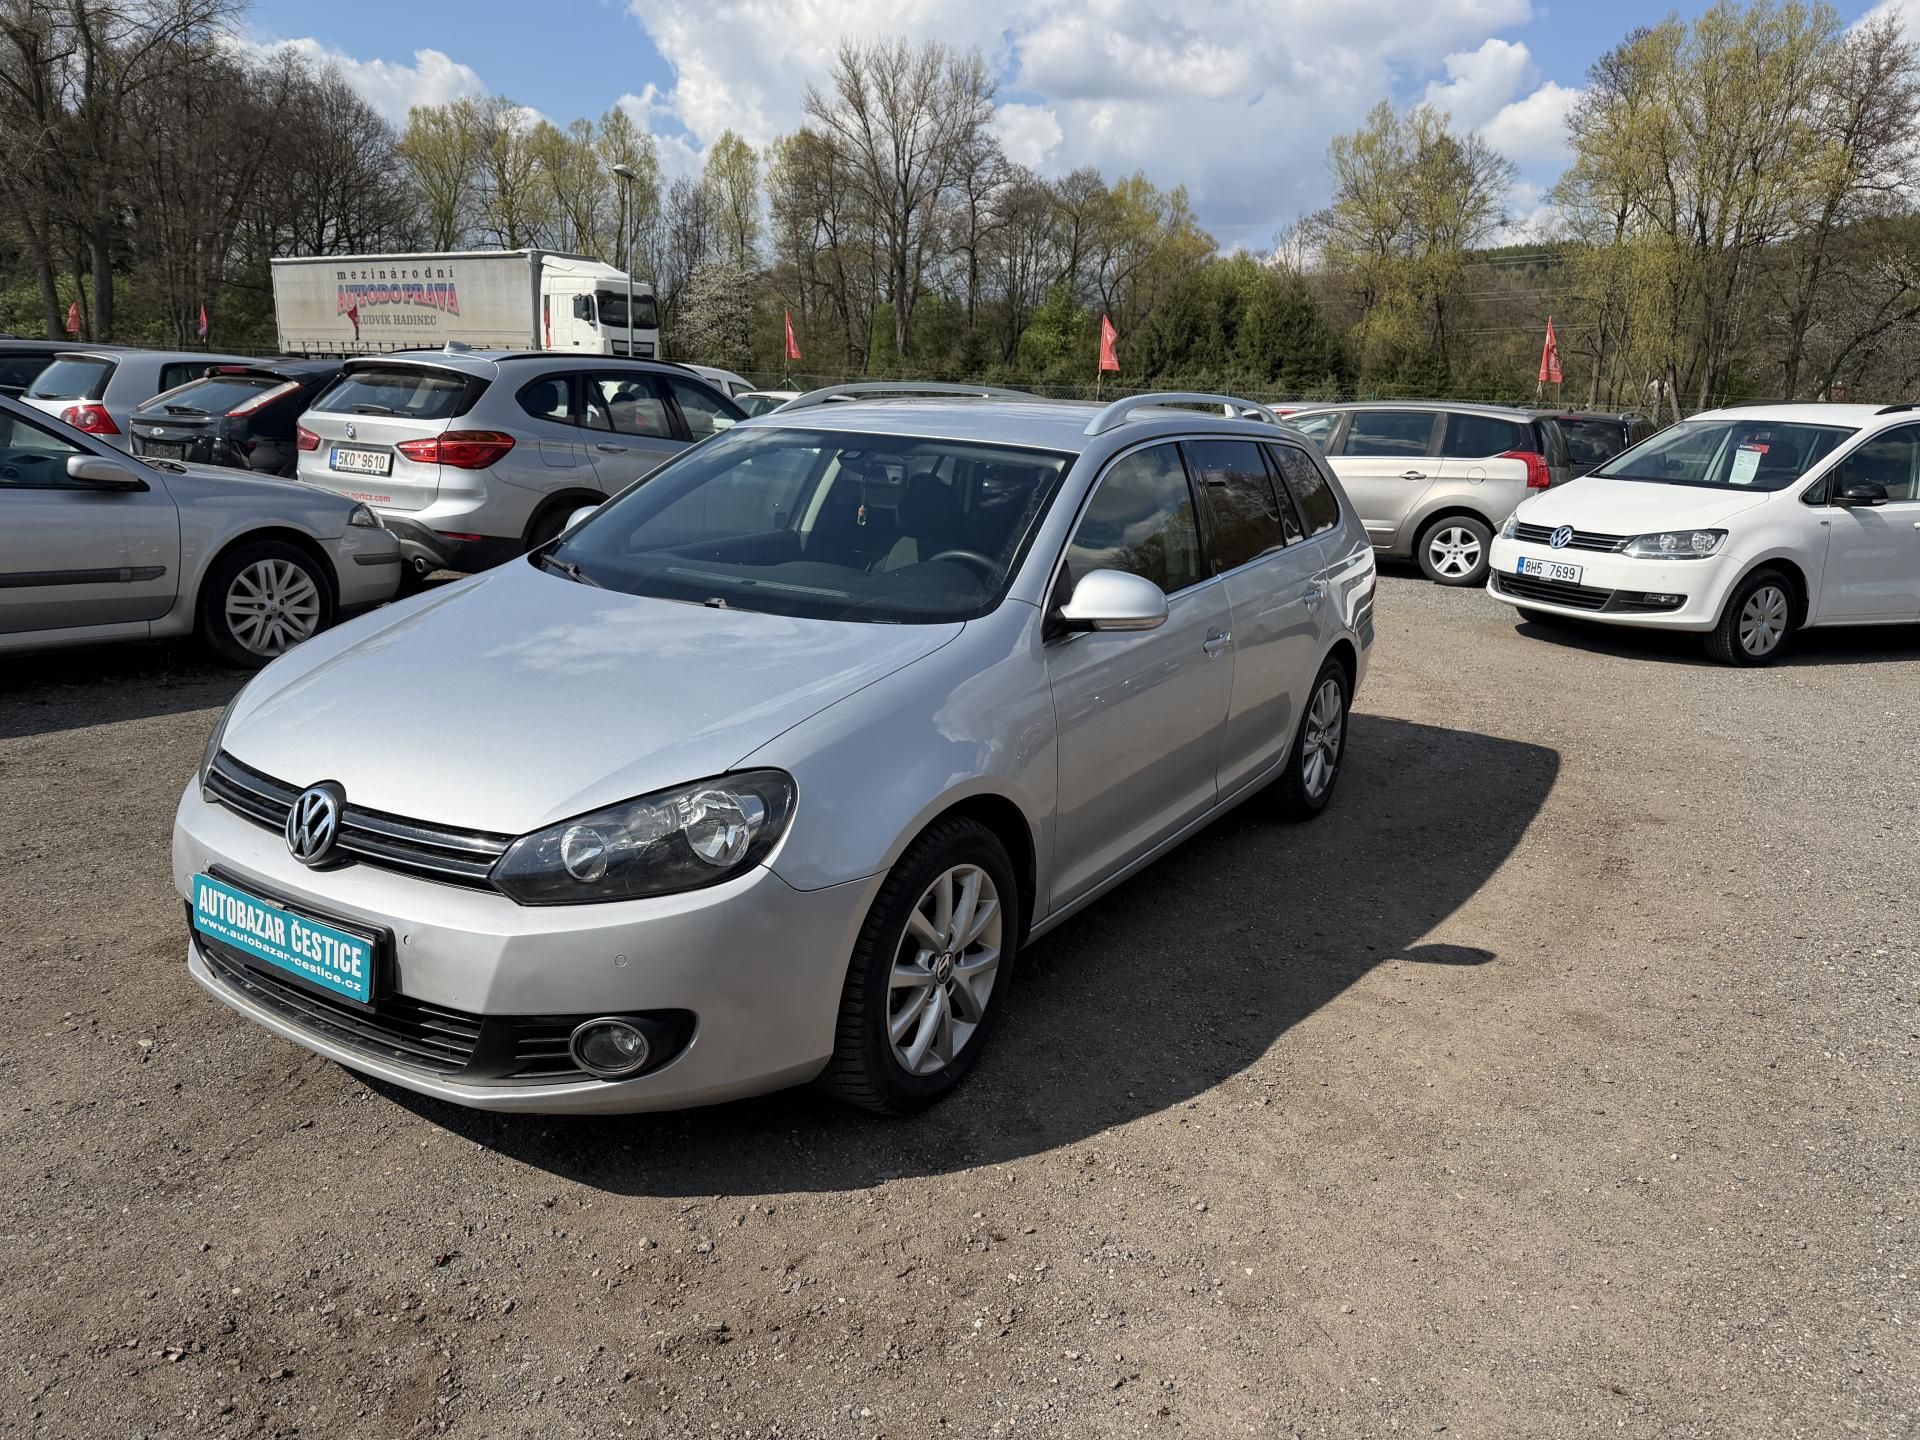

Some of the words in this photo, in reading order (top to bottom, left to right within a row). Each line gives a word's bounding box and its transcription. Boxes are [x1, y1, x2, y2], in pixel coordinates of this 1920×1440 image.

[337, 266, 454, 280] mezinárodní
[336, 283, 460, 317] AUTODOPRAVA
[361, 454, 385, 470] 9610
[1525, 560, 1543, 575] 8H5
[1549, 564, 1576, 580] 7699
[198, 884, 286, 947] AUTOBAZAR
[290, 919, 363, 978] ČESTICE
[199, 915, 362, 992] www.autobazar-cestice.cz
